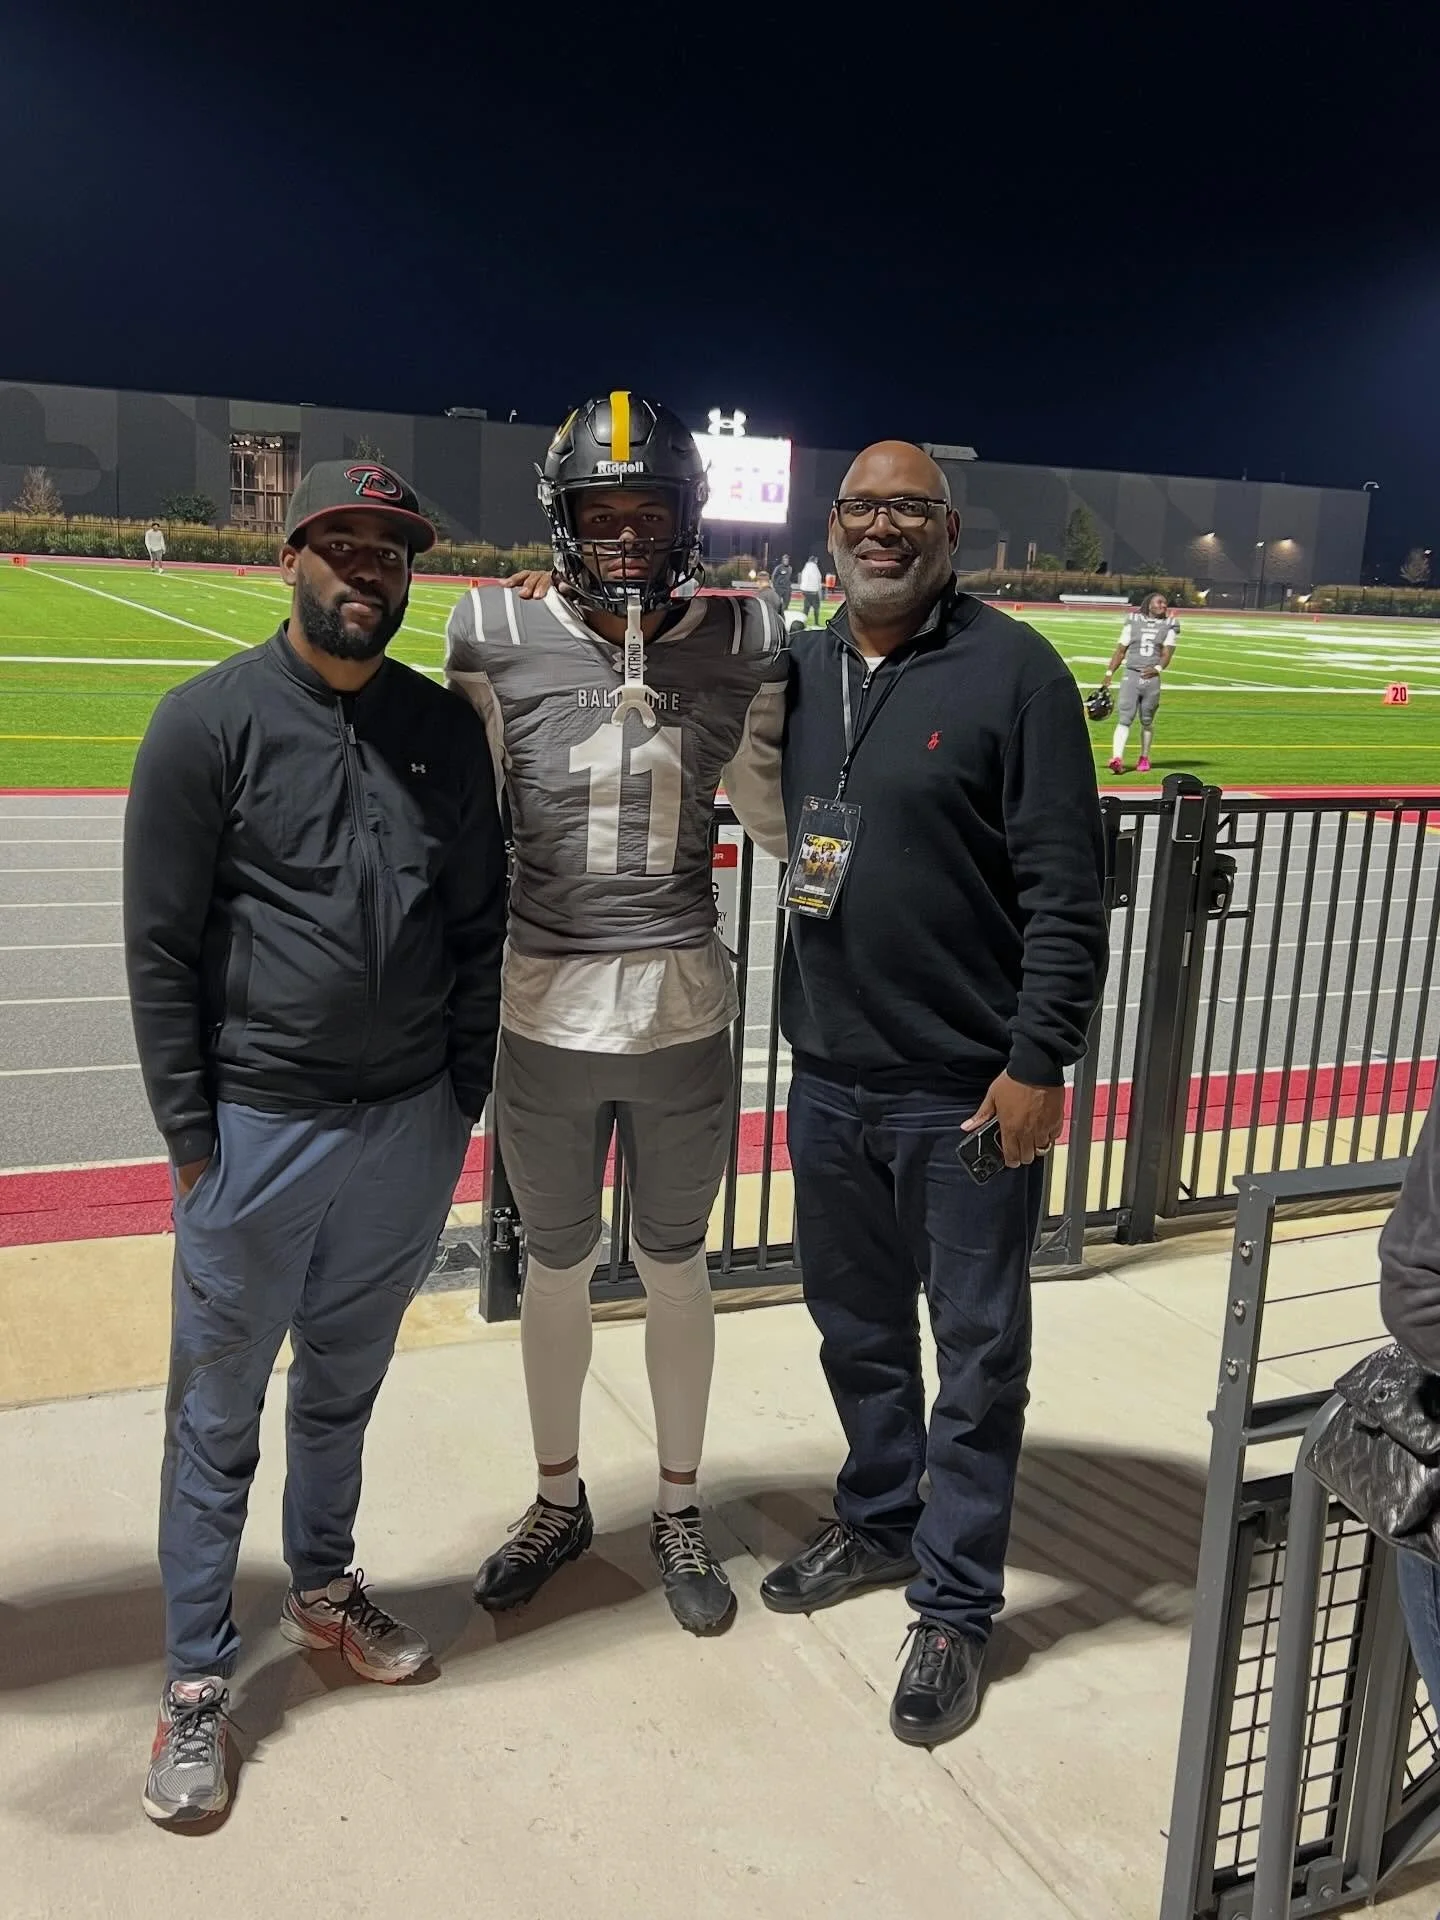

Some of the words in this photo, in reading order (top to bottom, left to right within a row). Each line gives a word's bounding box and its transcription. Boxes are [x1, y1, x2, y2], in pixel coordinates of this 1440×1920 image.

[597, 461, 644, 474] Riddell
[1140, 632, 1157, 657] 5
[628, 643, 641, 679] NXTRND
[577, 688, 681, 711] BALTORE
[1392, 686, 1407, 702] 20
[569, 723, 682, 875] 11
